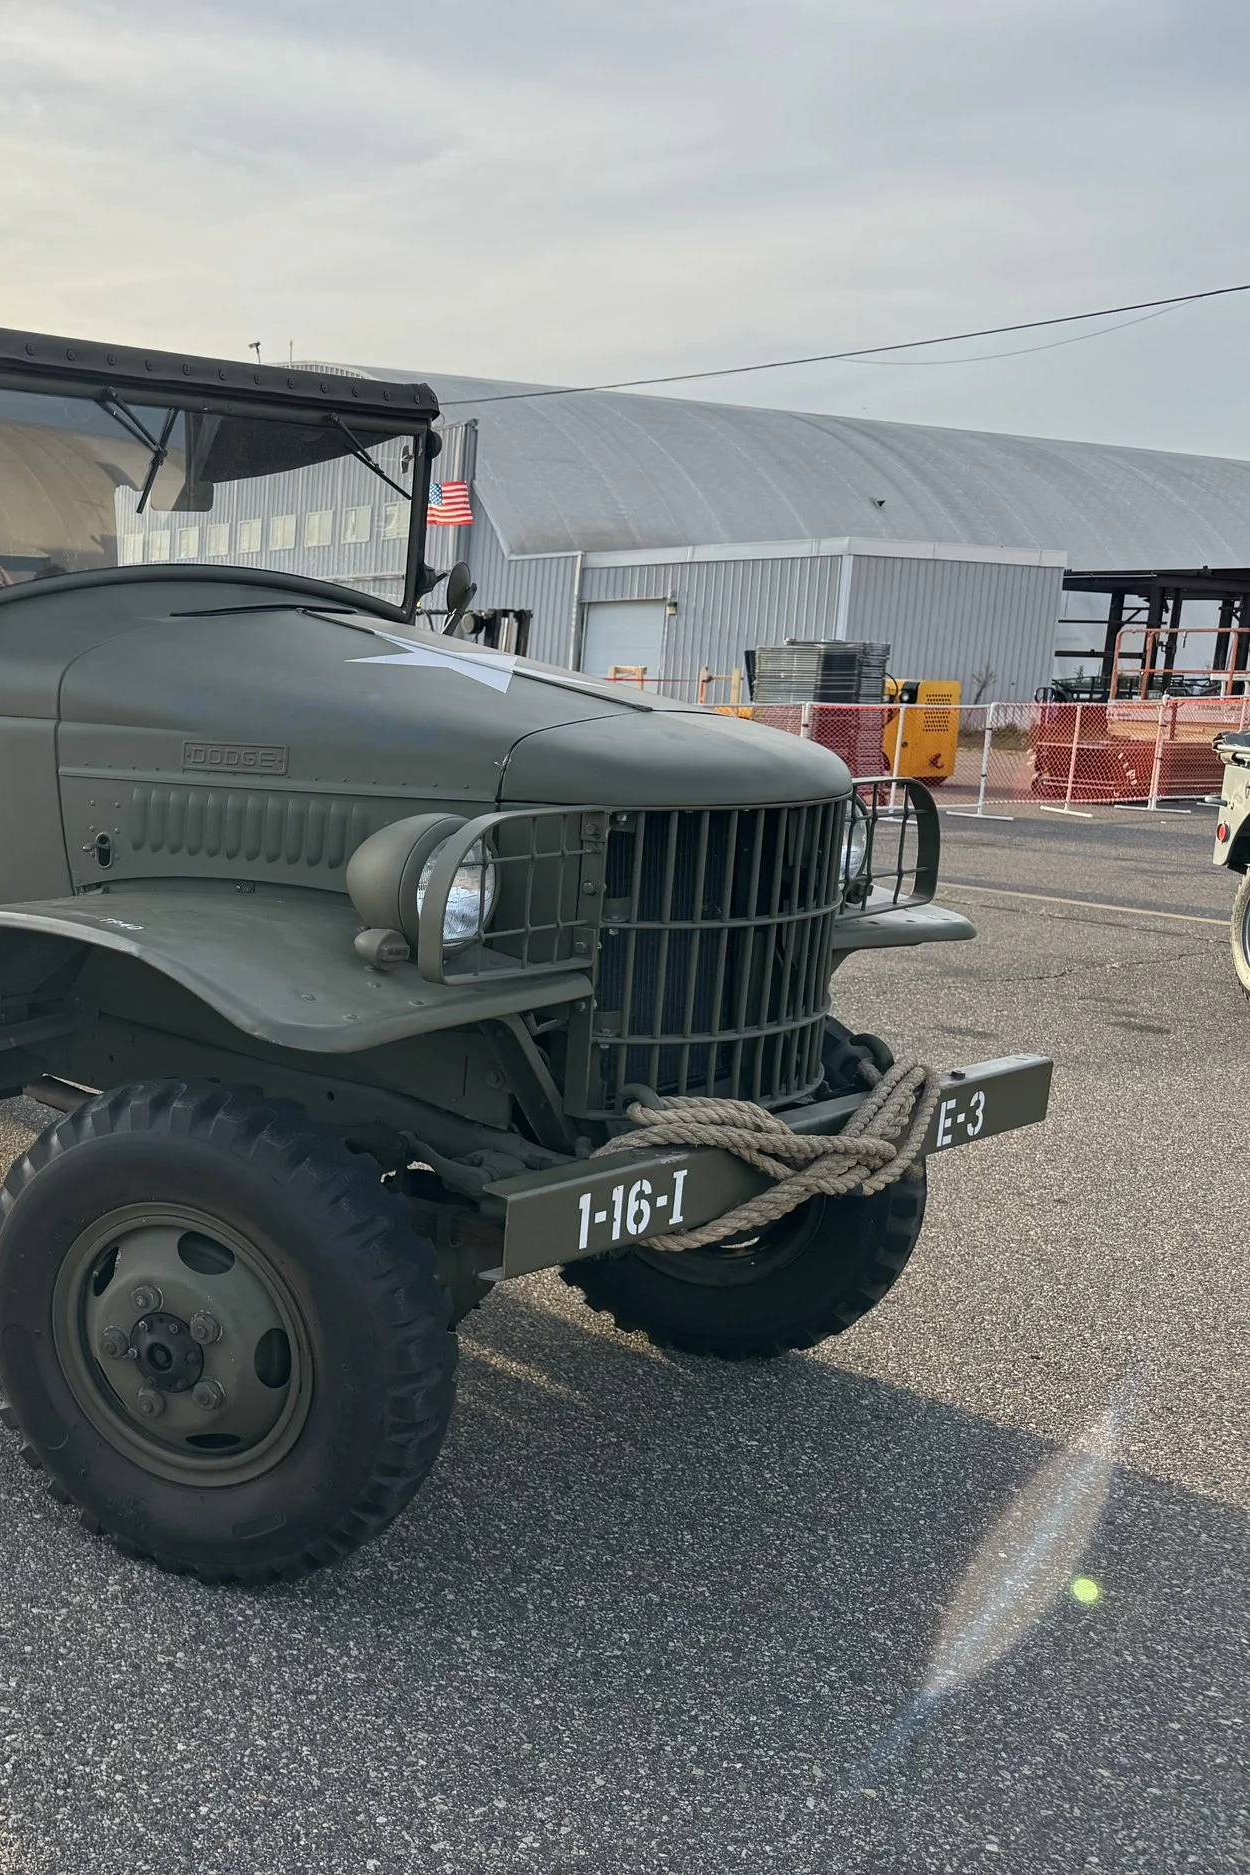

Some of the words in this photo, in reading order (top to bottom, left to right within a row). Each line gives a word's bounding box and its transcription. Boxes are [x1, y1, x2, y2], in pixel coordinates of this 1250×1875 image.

[190, 747, 276, 769] DODGE
[936, 1090, 986, 1148] E-3
[578, 1168, 688, 1250] 1-16-I
